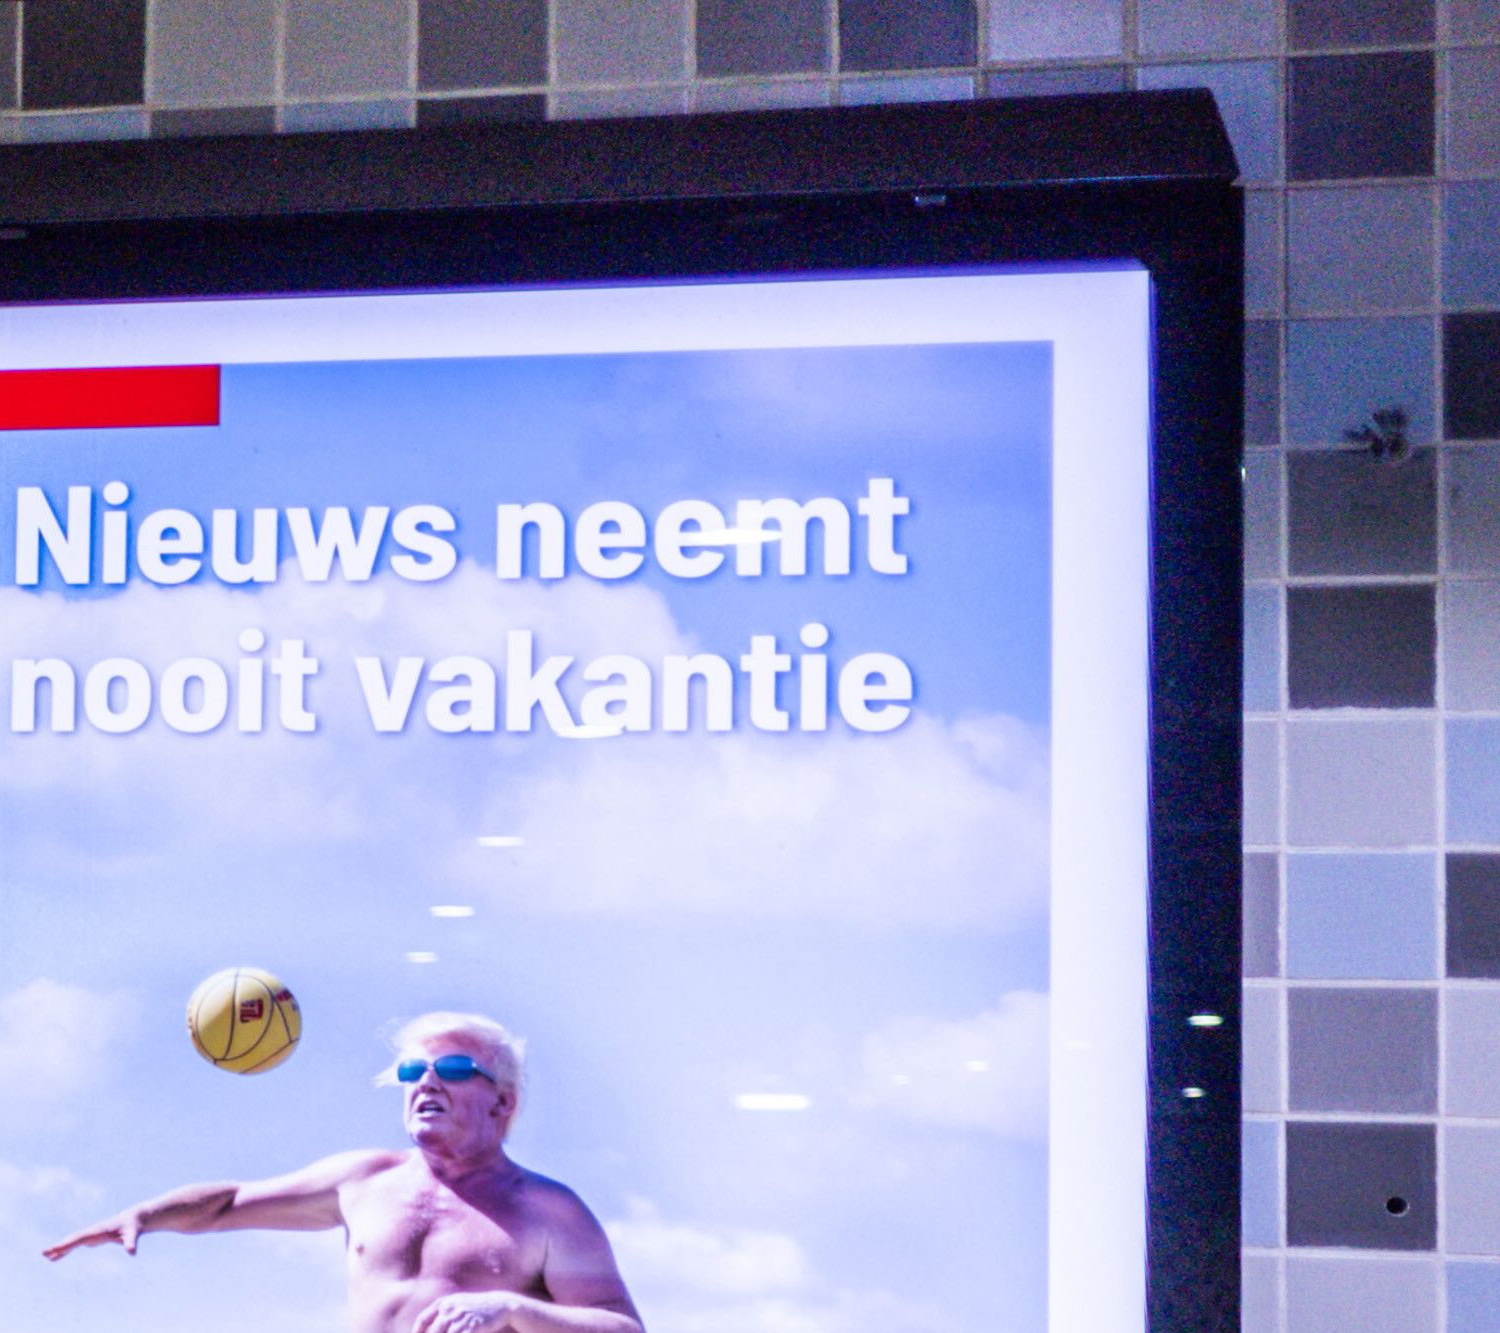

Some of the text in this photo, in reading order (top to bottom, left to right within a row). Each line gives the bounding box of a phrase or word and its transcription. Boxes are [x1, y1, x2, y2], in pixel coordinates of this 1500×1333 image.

[14, 477, 908, 586] Nieuws neemt
[10, 622, 913, 733] nooit vakantie
